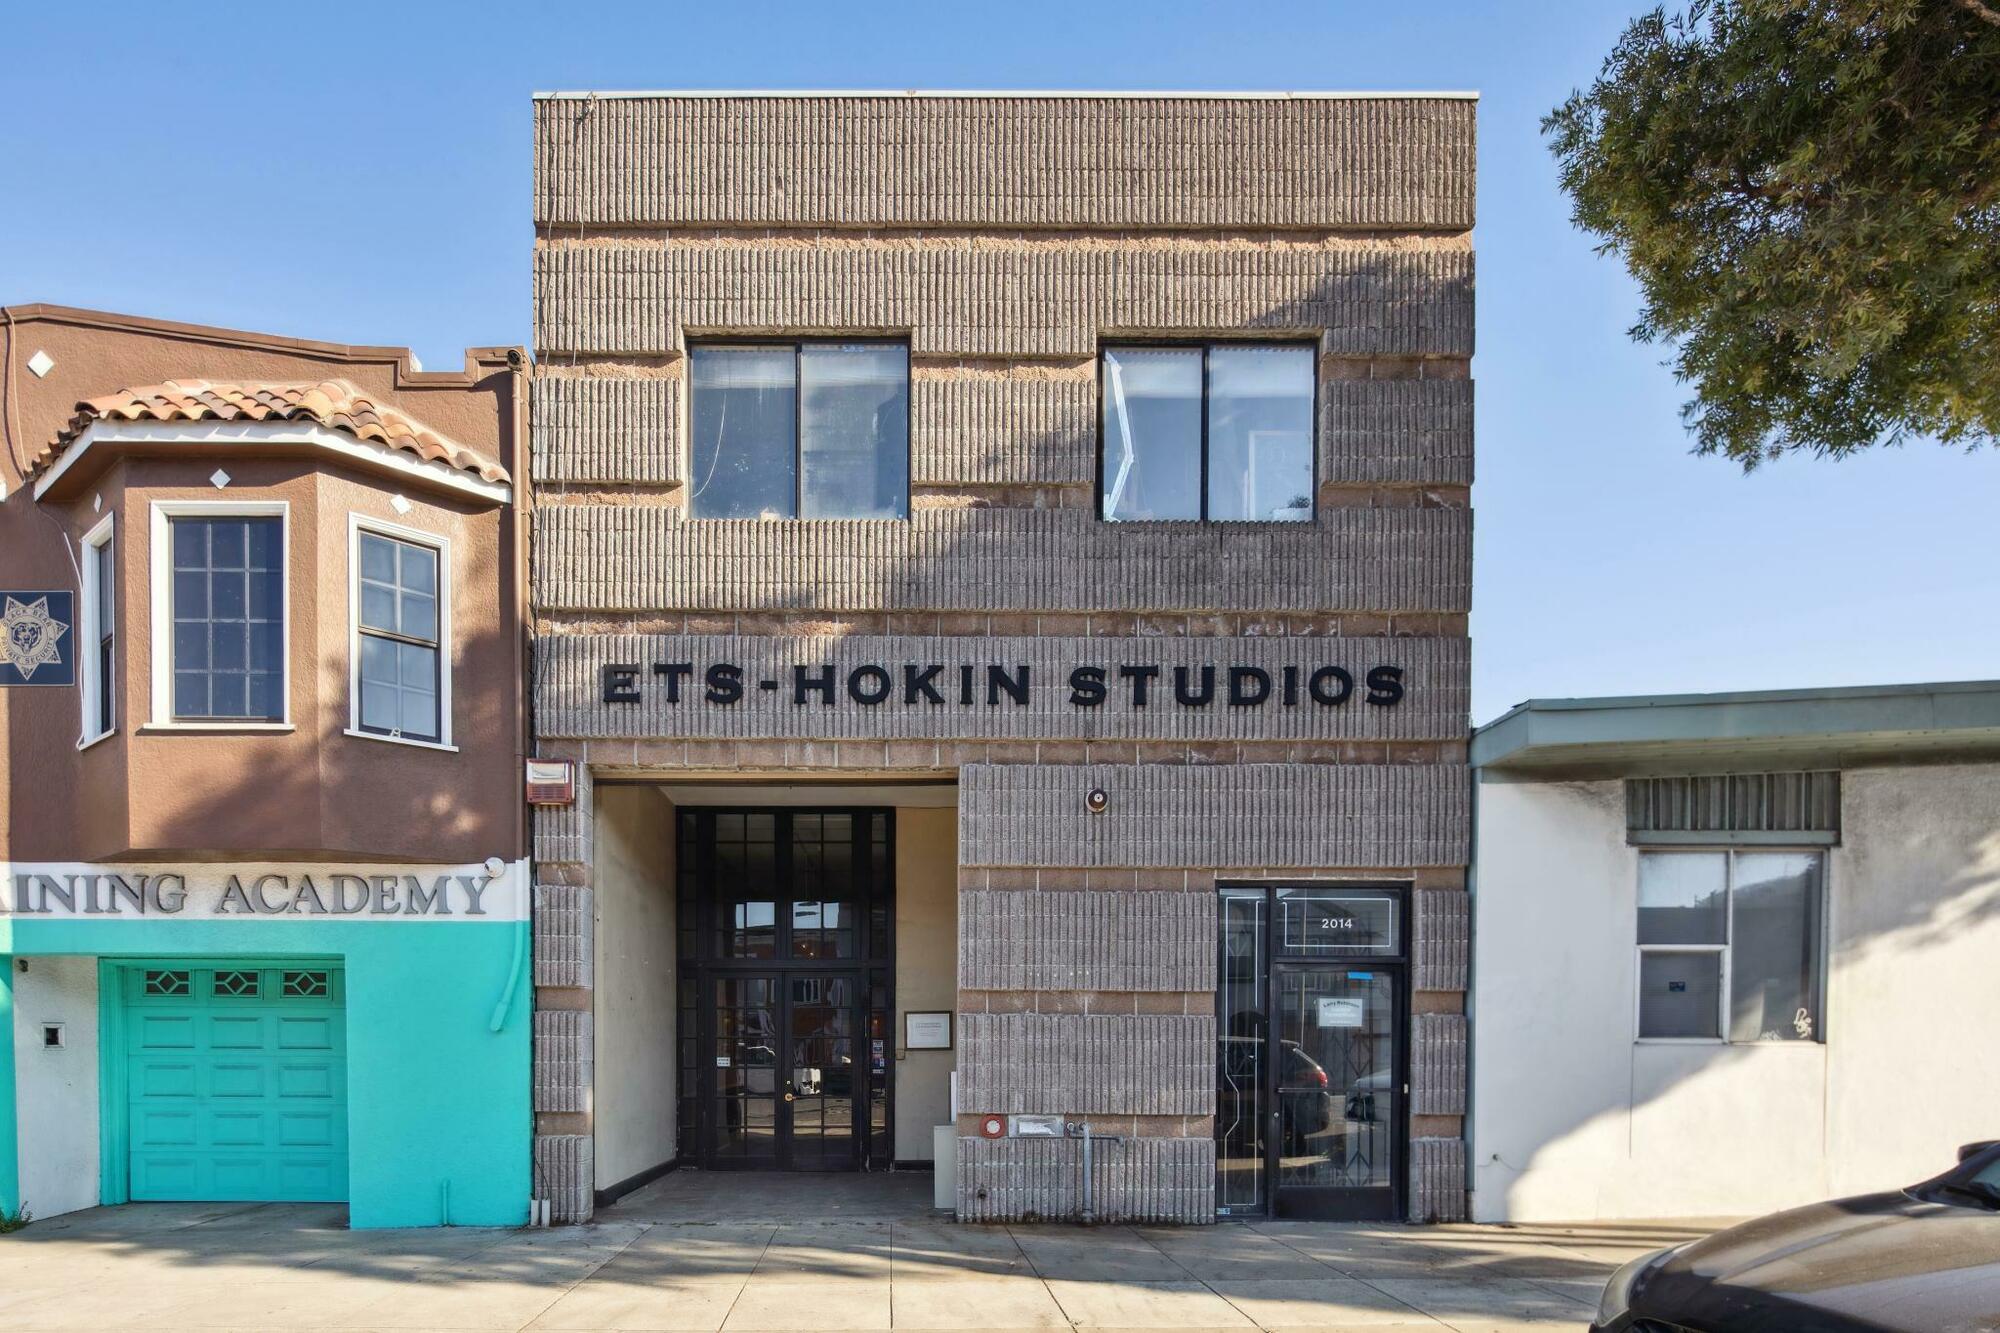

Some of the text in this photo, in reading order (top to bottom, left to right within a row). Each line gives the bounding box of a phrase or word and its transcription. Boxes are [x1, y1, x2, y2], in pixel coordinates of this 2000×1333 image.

[2, 609, 52, 627] BLACK BEAR
[1, 636, 55, 664] PRIVATE SECURITY
[602, 662, 1404, 706] ETS-HOKIN STUDIOS
[213, 874, 493, 915] ACADEMY
[1321, 918, 1352, 929] 2014
